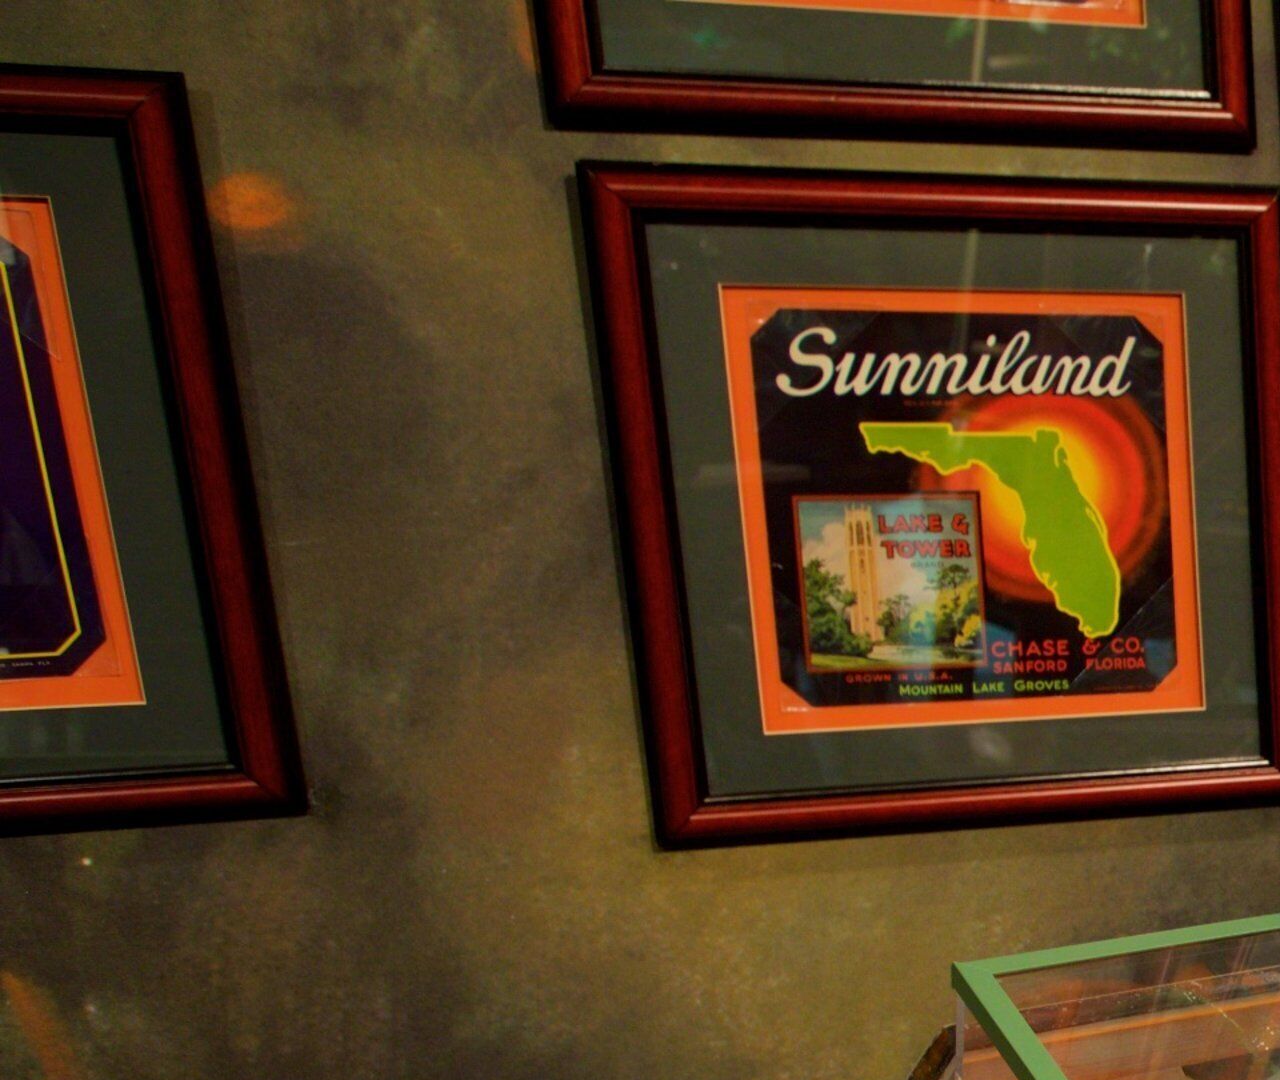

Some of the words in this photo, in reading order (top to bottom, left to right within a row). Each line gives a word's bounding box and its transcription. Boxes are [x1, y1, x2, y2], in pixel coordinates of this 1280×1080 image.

[776, 327, 1136, 397] Sunniland
[878, 514, 943, 536] LAKE
[951, 513, 969, 536] &
[880, 539, 971, 559] TOWER
[991, 638, 1070, 658] CHASE
[1082, 639, 1100, 657] &
[1111, 636, 1145, 656] CO.
[993, 659, 1067, 675] SANFORD
[1085, 657, 1146, 673] FLORIDA
[845, 673, 892, 684] GROWN
[899, 682, 964, 697] MOUNTAIN
[972, 680, 1005, 694] LAKE
[1013, 679, 1070, 692] GROVES
